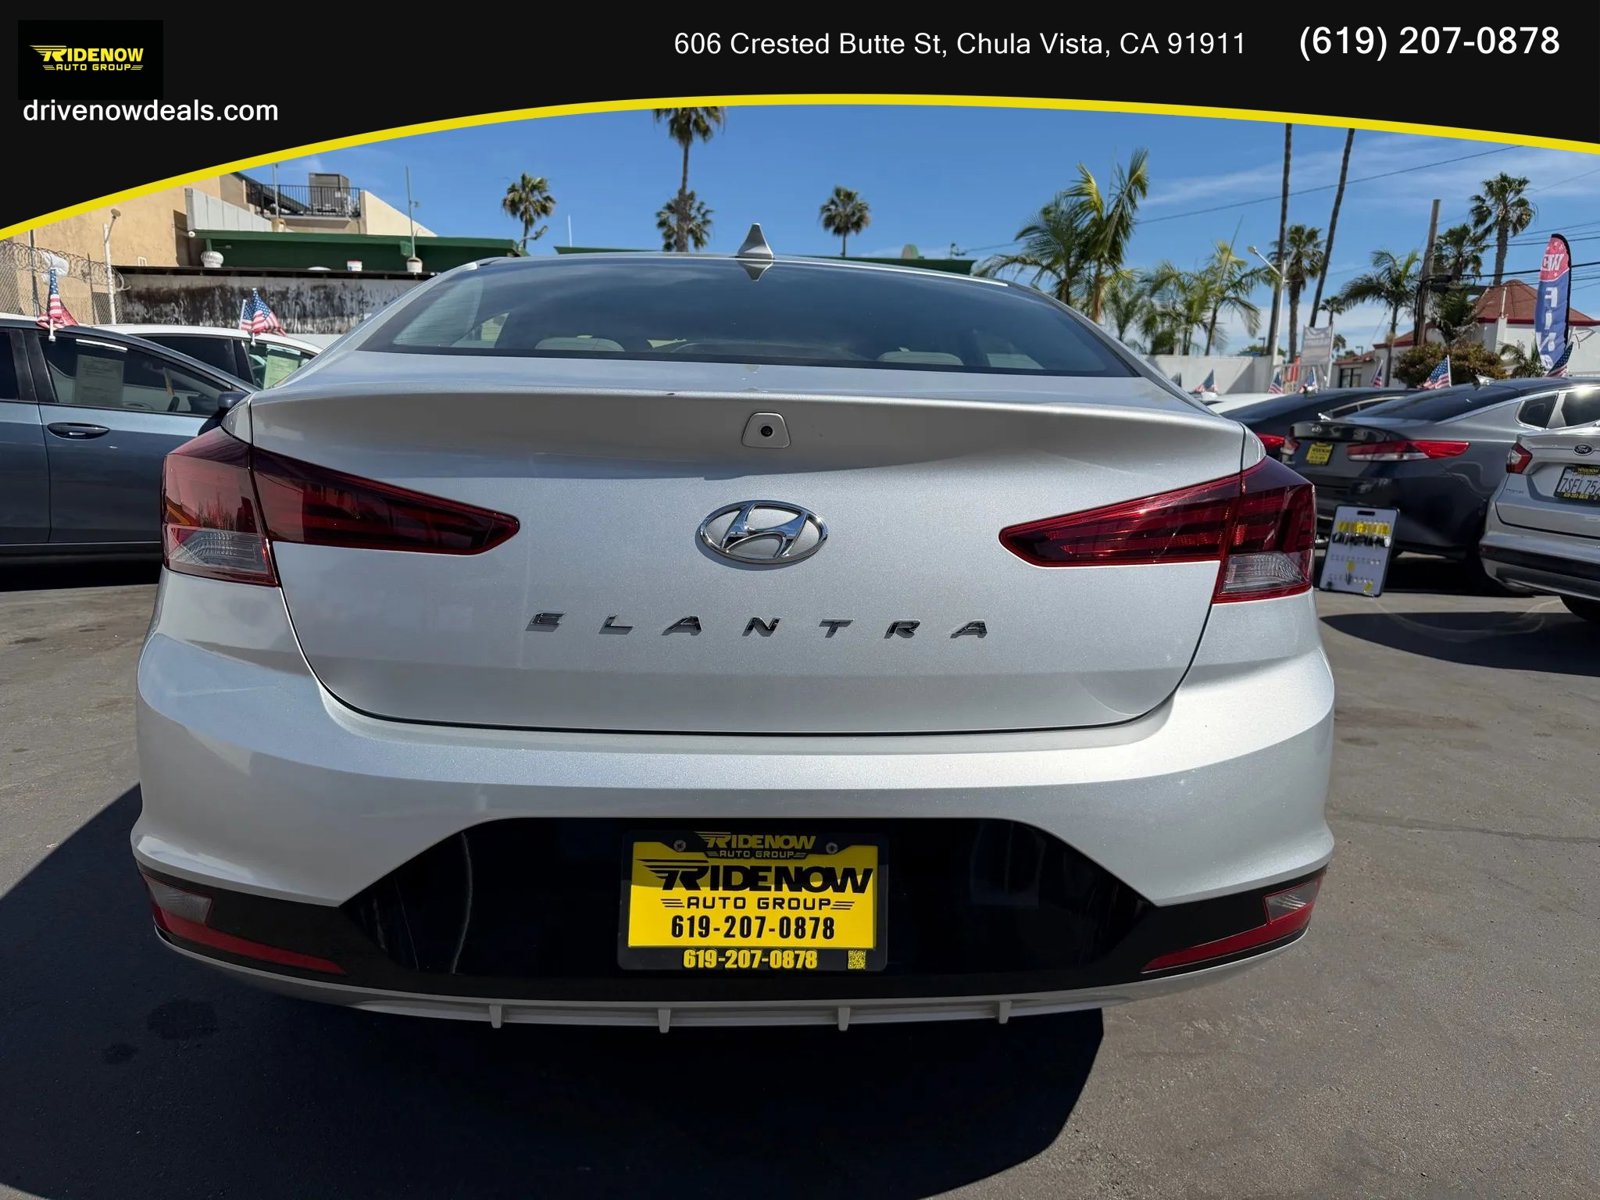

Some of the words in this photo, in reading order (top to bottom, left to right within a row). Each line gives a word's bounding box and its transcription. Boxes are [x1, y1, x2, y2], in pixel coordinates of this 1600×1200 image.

[525, 611, 988, 639] ELANTRA
[695, 831, 816, 849] RIDENOW
[720, 850, 750, 858] AUTO
[755, 850, 795, 858] GROUP
[637, 859, 873, 894] RIDENOW
[686, 896, 746, 910] AUTO
[757, 897, 832, 910] GROUP
[671, 915, 835, 940] 619-207-0878
[682, 948, 818, 969] 619-207-0878
